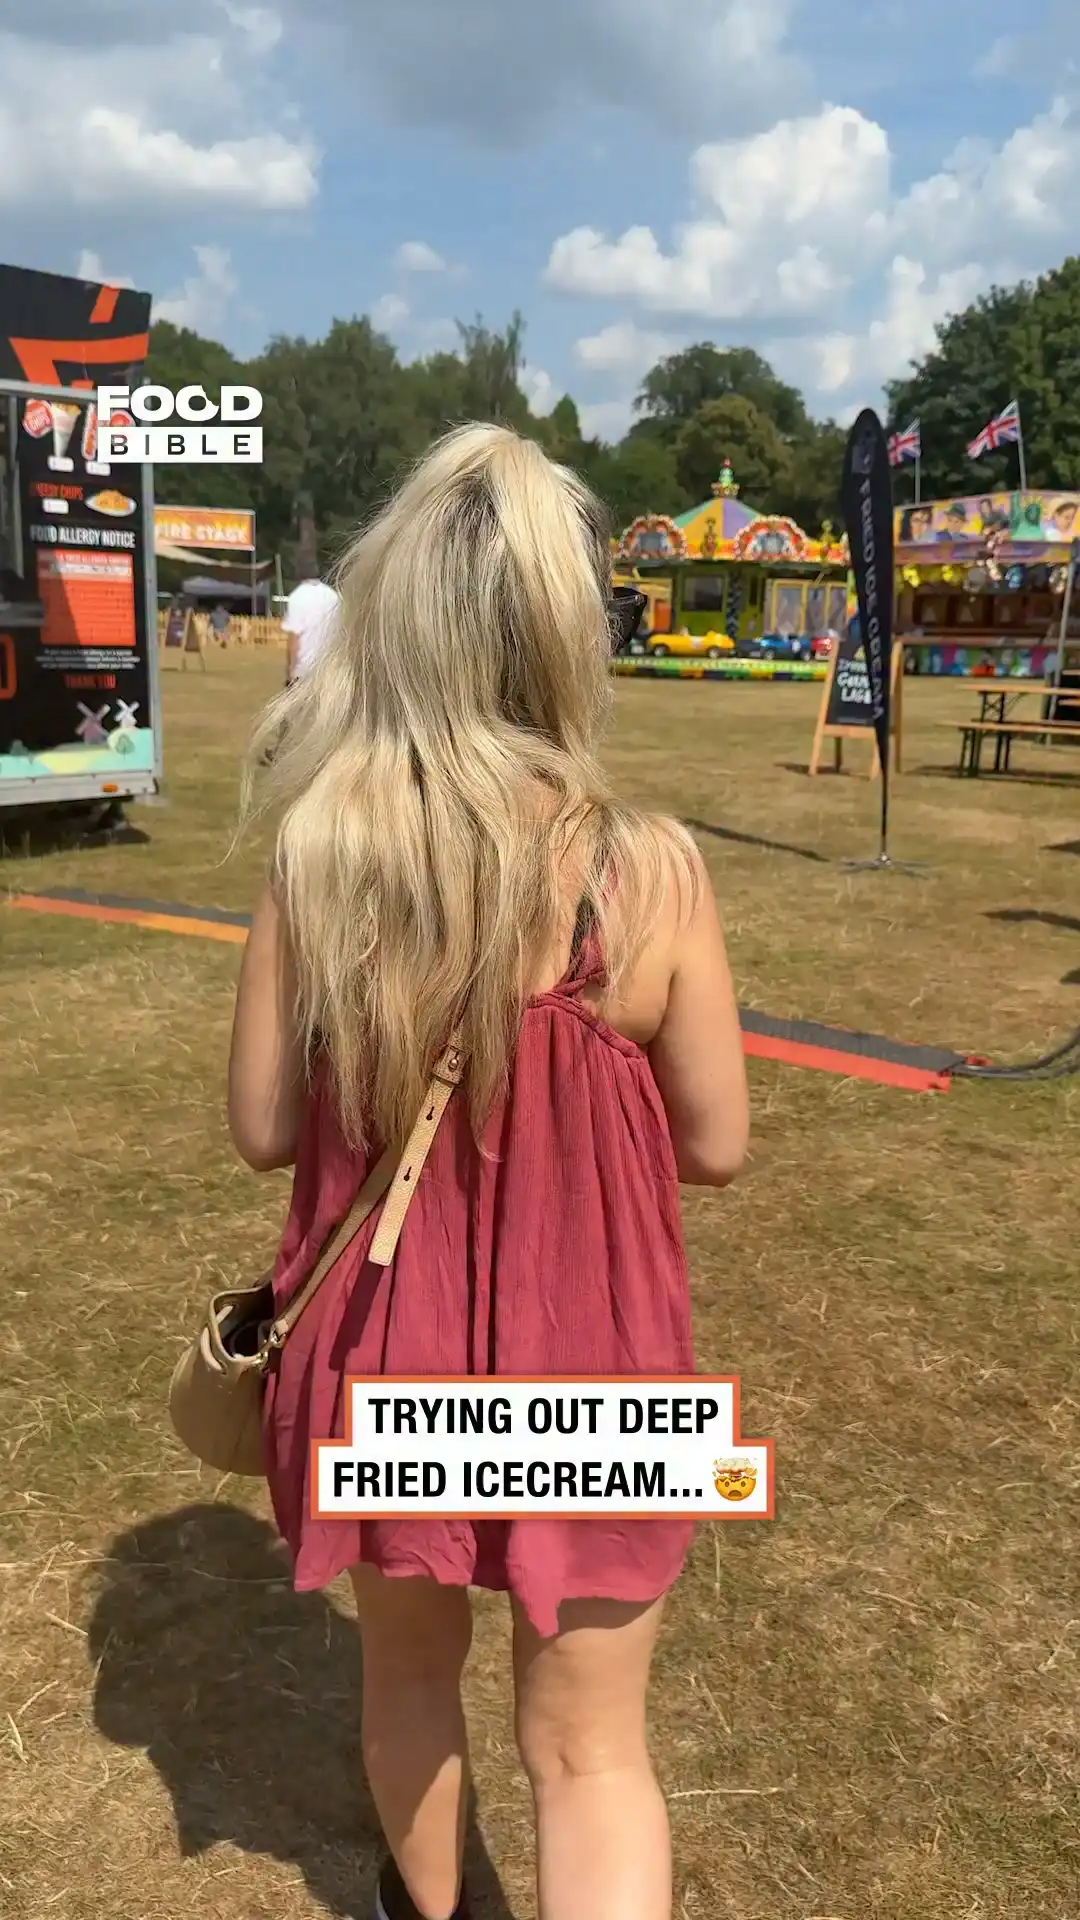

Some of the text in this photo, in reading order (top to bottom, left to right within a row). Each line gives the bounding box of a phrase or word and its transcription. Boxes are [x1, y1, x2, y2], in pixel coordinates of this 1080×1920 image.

[30, 525, 136, 549] FOOD ALLERGY NOTICE
[858, 478, 885, 720] FRIED ICE CREAM
